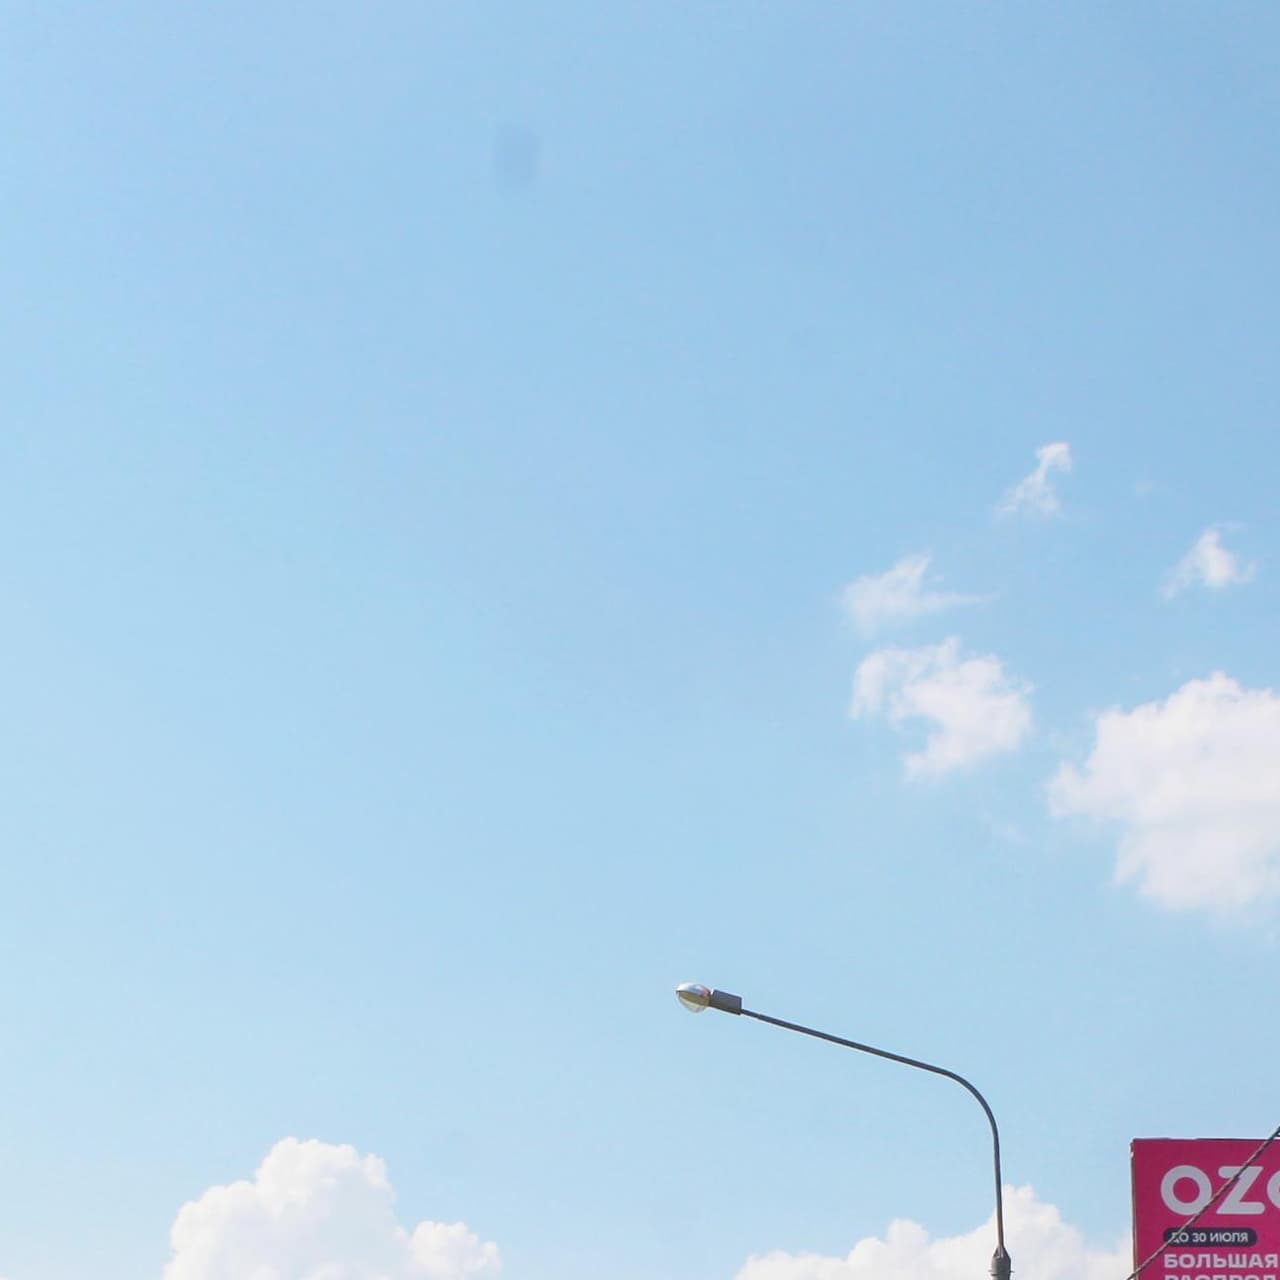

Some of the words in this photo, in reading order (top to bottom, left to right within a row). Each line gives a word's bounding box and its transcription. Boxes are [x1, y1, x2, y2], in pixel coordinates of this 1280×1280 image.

[1192, 1232, 1206, 1243] 30
[1209, 1232, 1249, 1243] ИЮЛЯ
[1164, 1253, 1279, 1269] БОЛЬШАЯ
